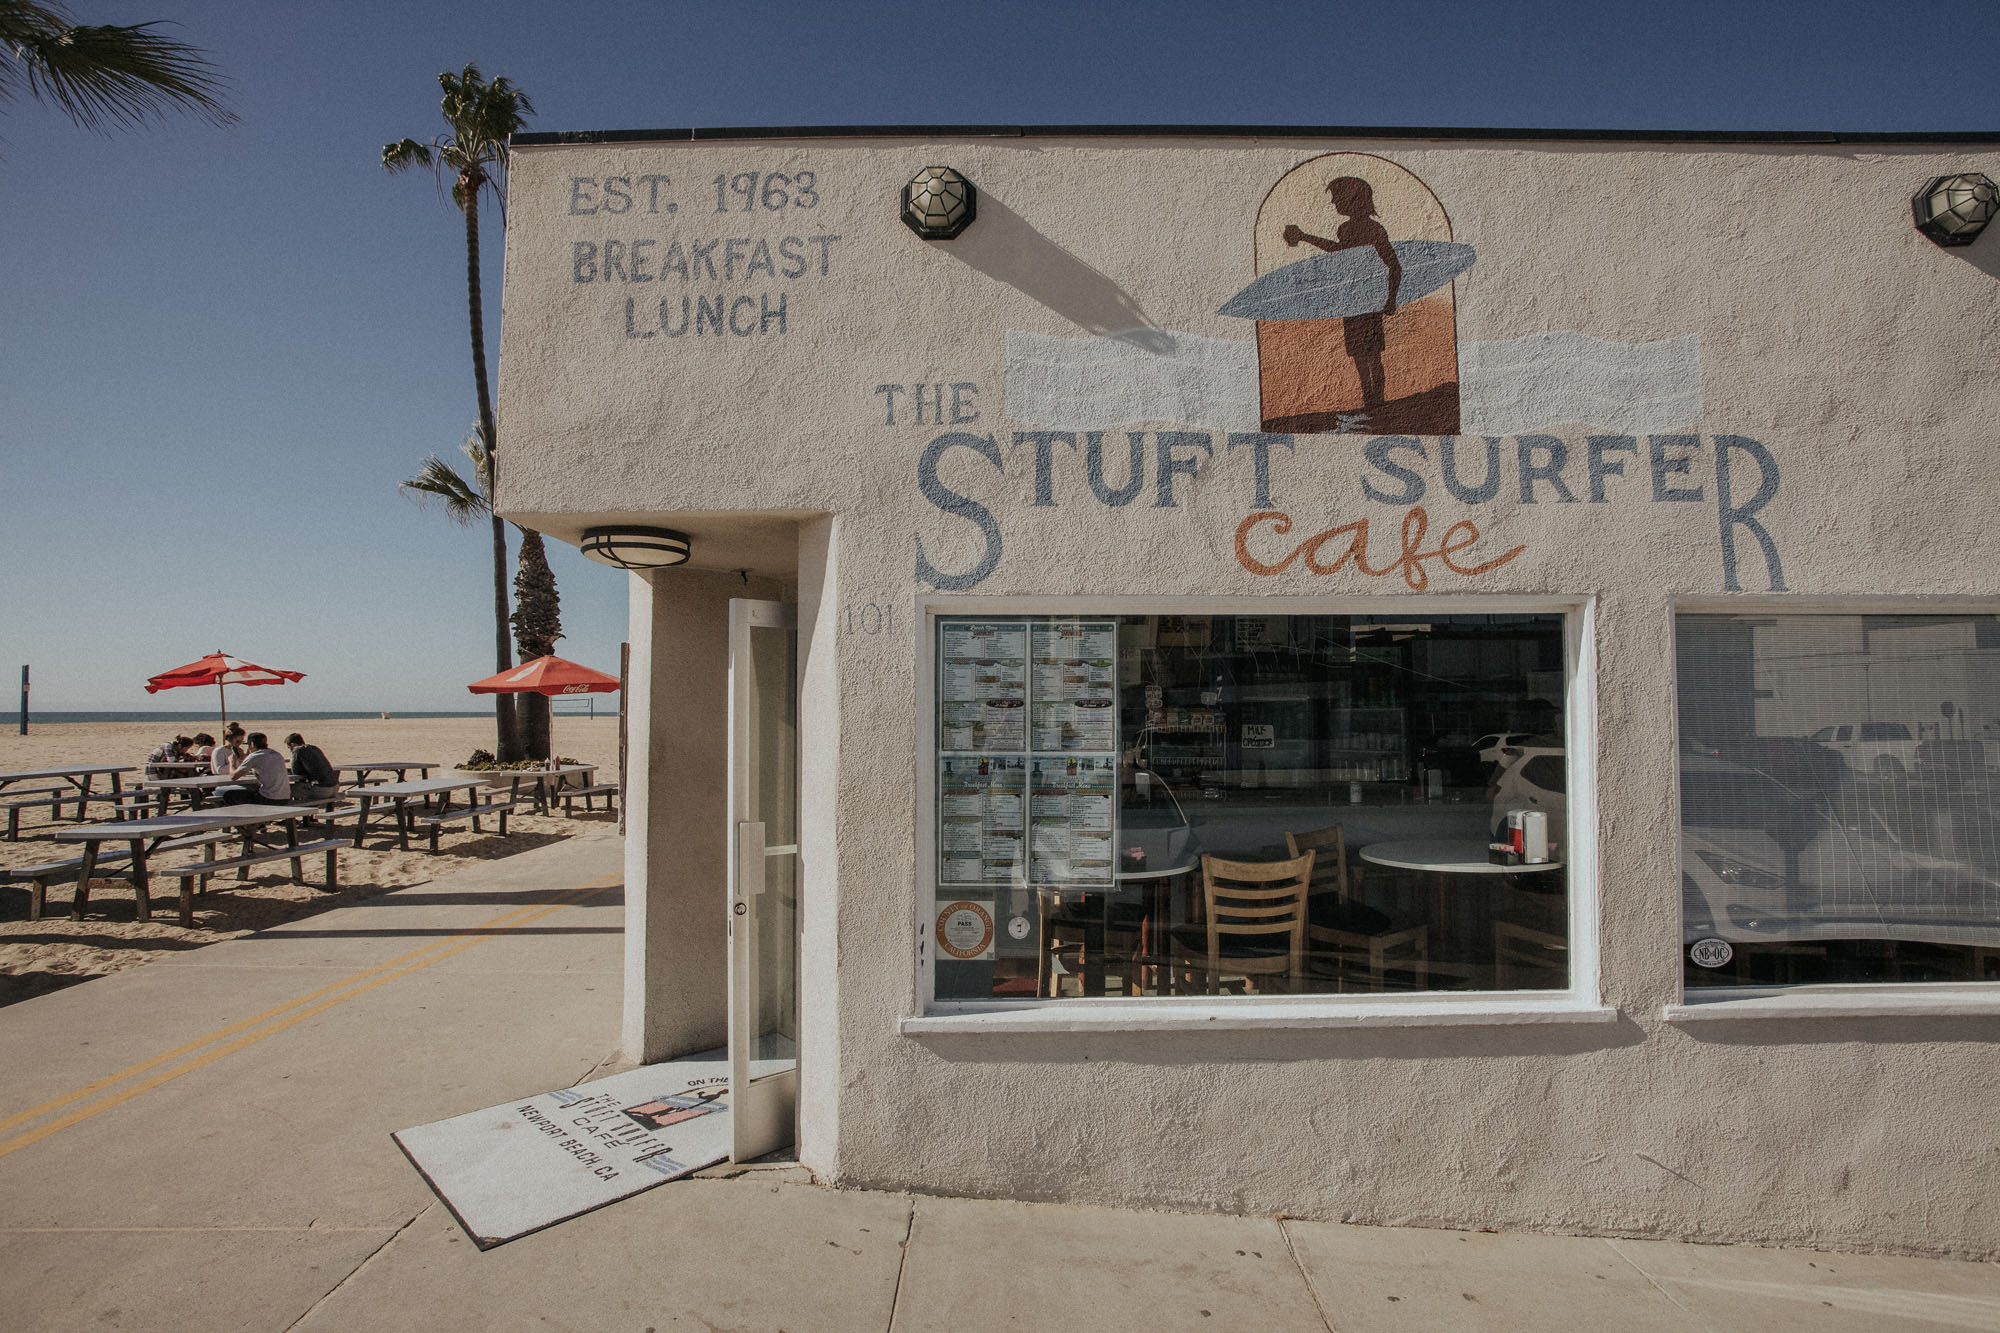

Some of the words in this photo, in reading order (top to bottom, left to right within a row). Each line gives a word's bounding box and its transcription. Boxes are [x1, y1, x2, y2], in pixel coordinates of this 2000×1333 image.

[568, 174, 679, 217] EST.
[713, 171, 821, 214] 1963
[572, 234, 843, 284] BREAKFAST
[624, 292, 789, 340] LUNCH
[874, 382, 982, 426] THE
[915, 431, 1296, 591] STUFT
[1361, 432, 1792, 592] SURFER
[845, 602, 894, 635] 101
[969, 903, 992, 932] ORANGE
[598, 1093, 622, 1108] THE
[688, 1079, 705, 1087] ON
[516, 1104, 568, 1139] NEWPORT
[594, 1165, 620, 1182] CA
